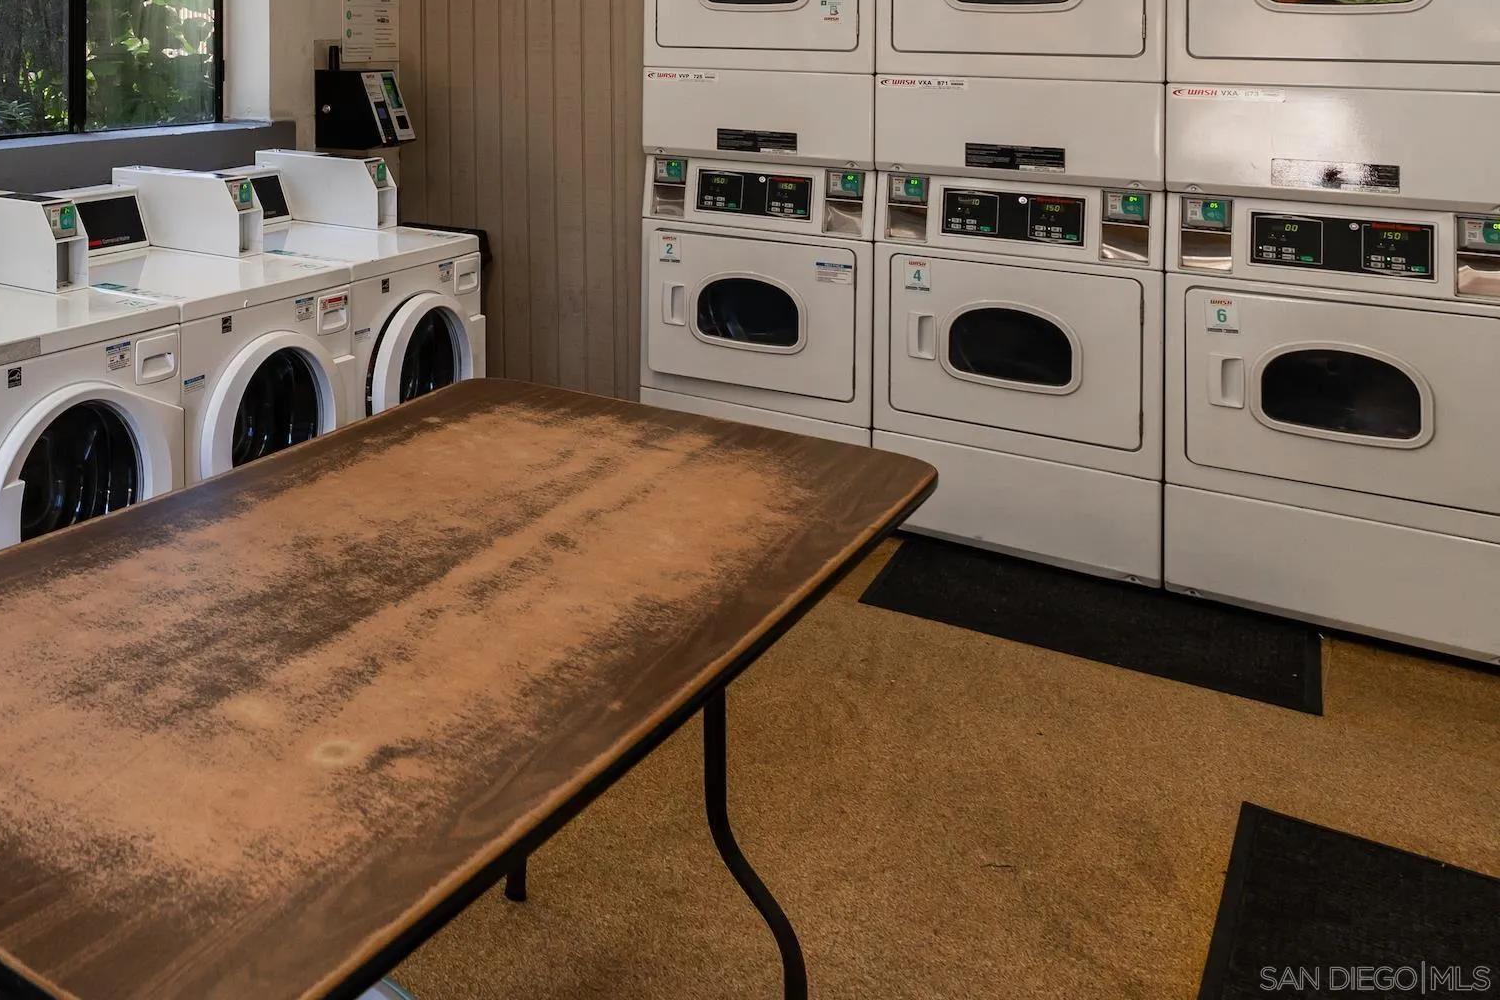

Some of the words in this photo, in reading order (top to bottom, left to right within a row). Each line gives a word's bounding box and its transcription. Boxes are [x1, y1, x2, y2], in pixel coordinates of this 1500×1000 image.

[666, 243, 673, 254] 2
[913, 269, 921, 282] 4
[1216, 308, 1227, 322] 6
